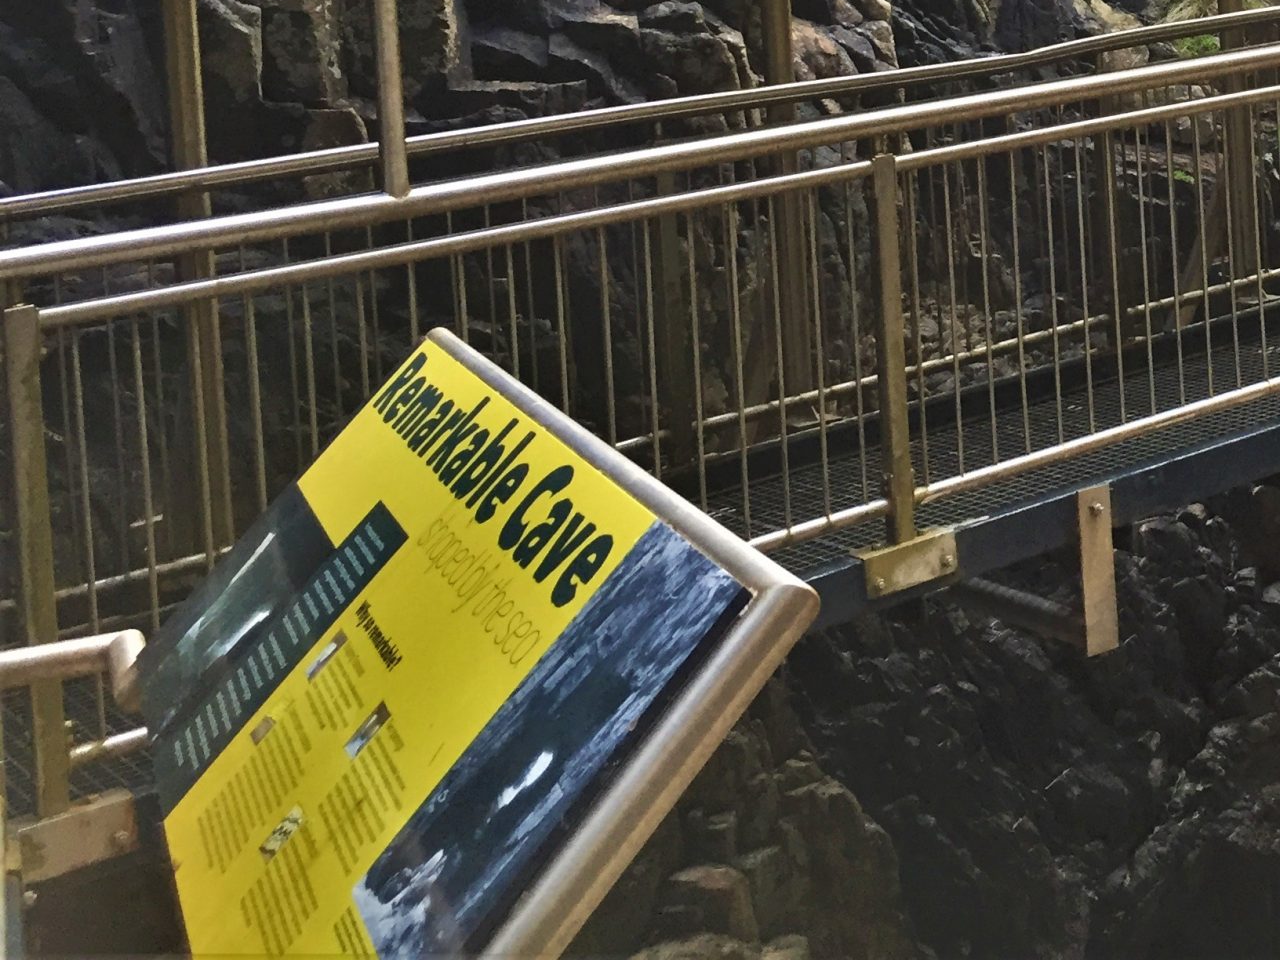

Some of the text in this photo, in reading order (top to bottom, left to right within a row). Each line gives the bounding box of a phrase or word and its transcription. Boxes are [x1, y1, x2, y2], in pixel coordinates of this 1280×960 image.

[372, 352, 536, 524] Remarkable
[498, 464, 614, 608] Cave
[355, 599, 372, 628] Why
[363, 616, 375, 632] so
[416, 501, 541, 667] shaped by the sea
